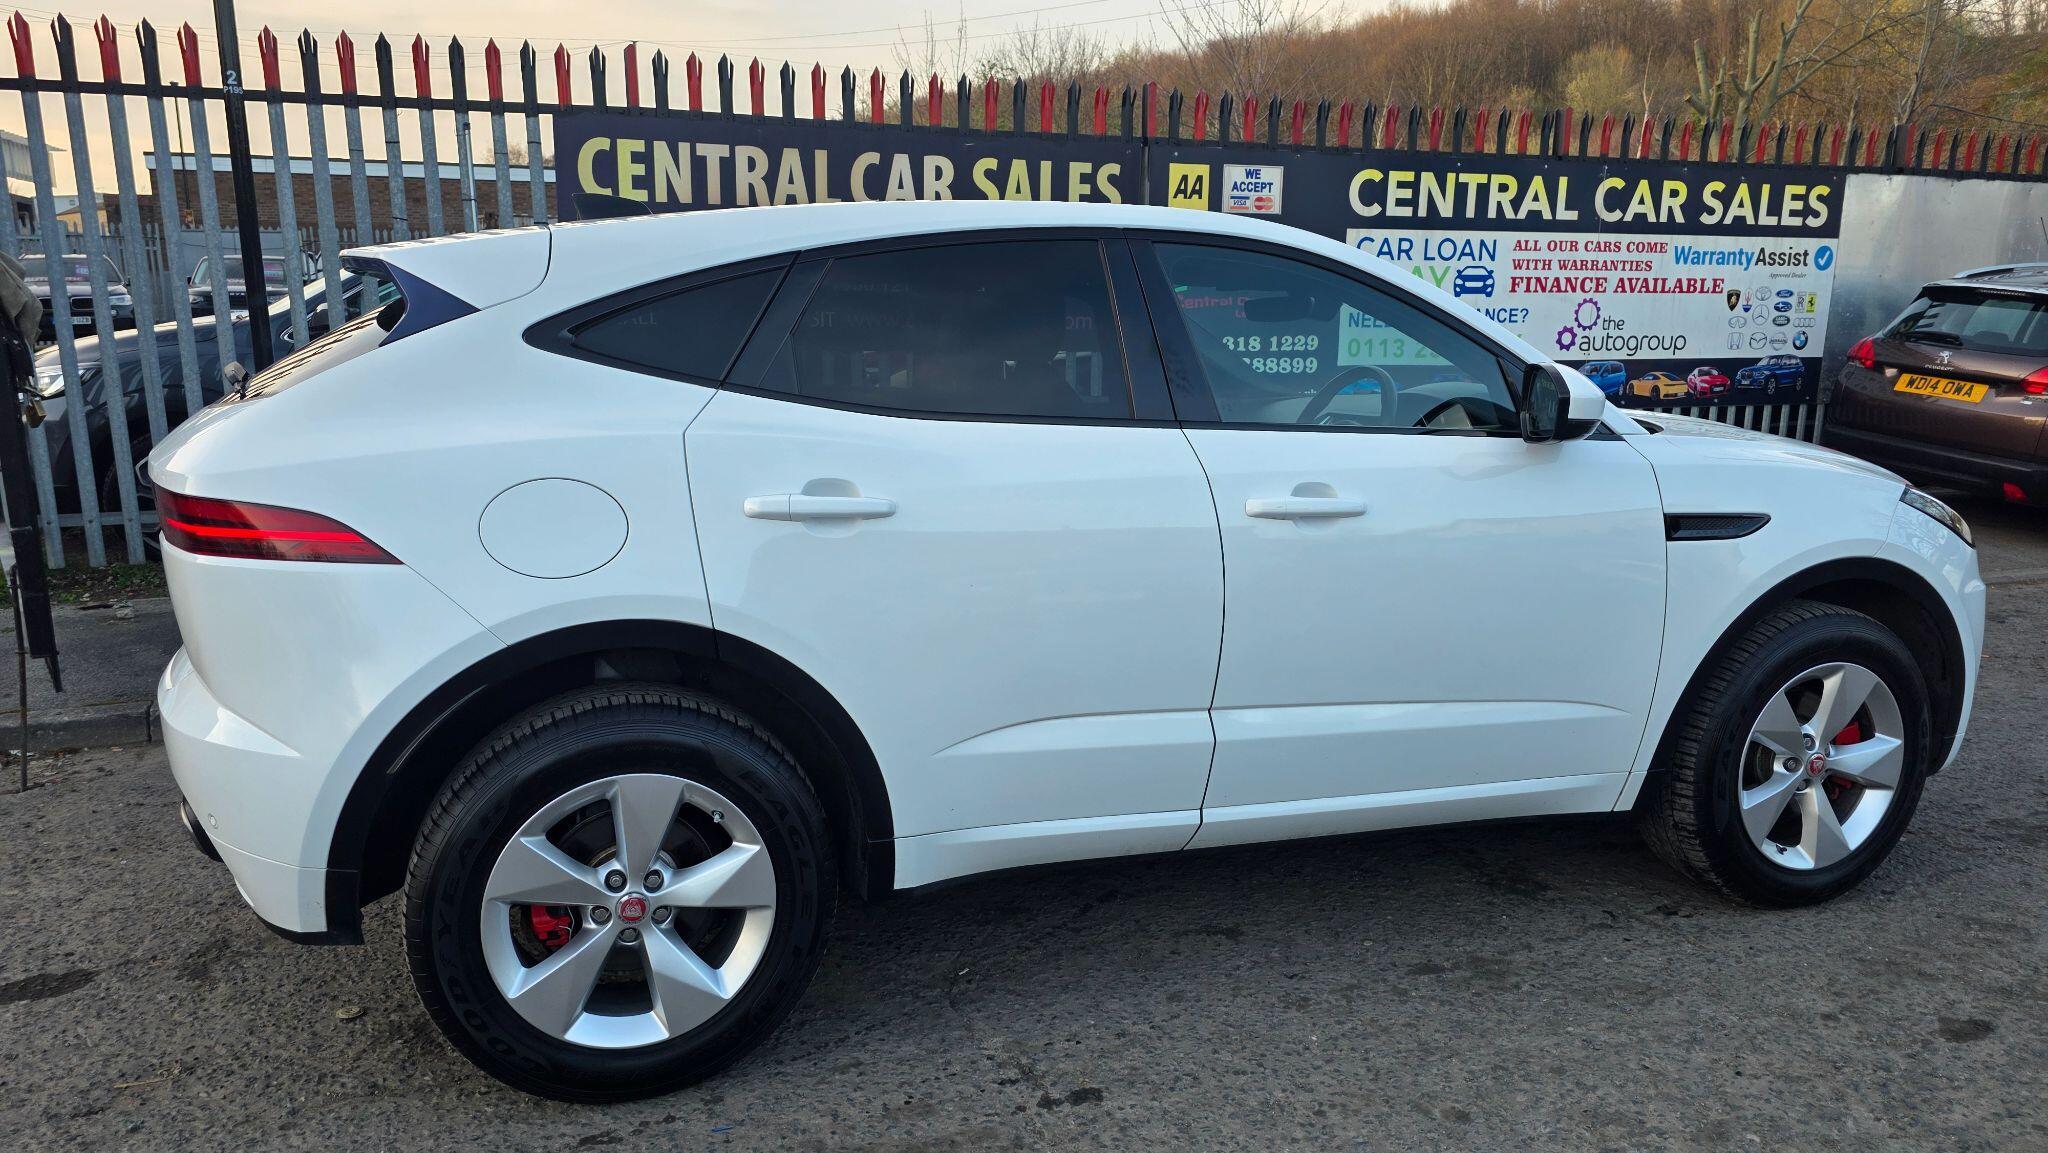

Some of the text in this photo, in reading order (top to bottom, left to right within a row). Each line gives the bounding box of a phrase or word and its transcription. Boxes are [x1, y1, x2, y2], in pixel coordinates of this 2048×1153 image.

[226, 70, 238, 85] 2
[577, 136, 1122, 206] CENTRAL CAR SALES
[1244, 168, 1262, 180] WE
[1172, 174, 1204, 200] AA
[1231, 181, 1274, 193] ACCEPT
[1348, 168, 1831, 228] CENTRAL CAR SALES
[1423, 237, 1498, 262] LOAN
[1513, 239, 1669, 254] ALL OUR CARS COME
[1511, 258, 1654, 272] WITH WARRANTIES
[1509, 276, 1725, 295] FINANCE AVAILABLE
[1348, 312, 1393, 328] NEE
[1602, 315, 1625, 331] the
[1269, 335, 1319, 352] 1229
[1347, 338, 1405, 358] 0113
[1578, 332, 1688, 356] autogroup
[1242, 357, 1318, 374] 88899
[1905, 376, 1975, 399] WD14 OWA
